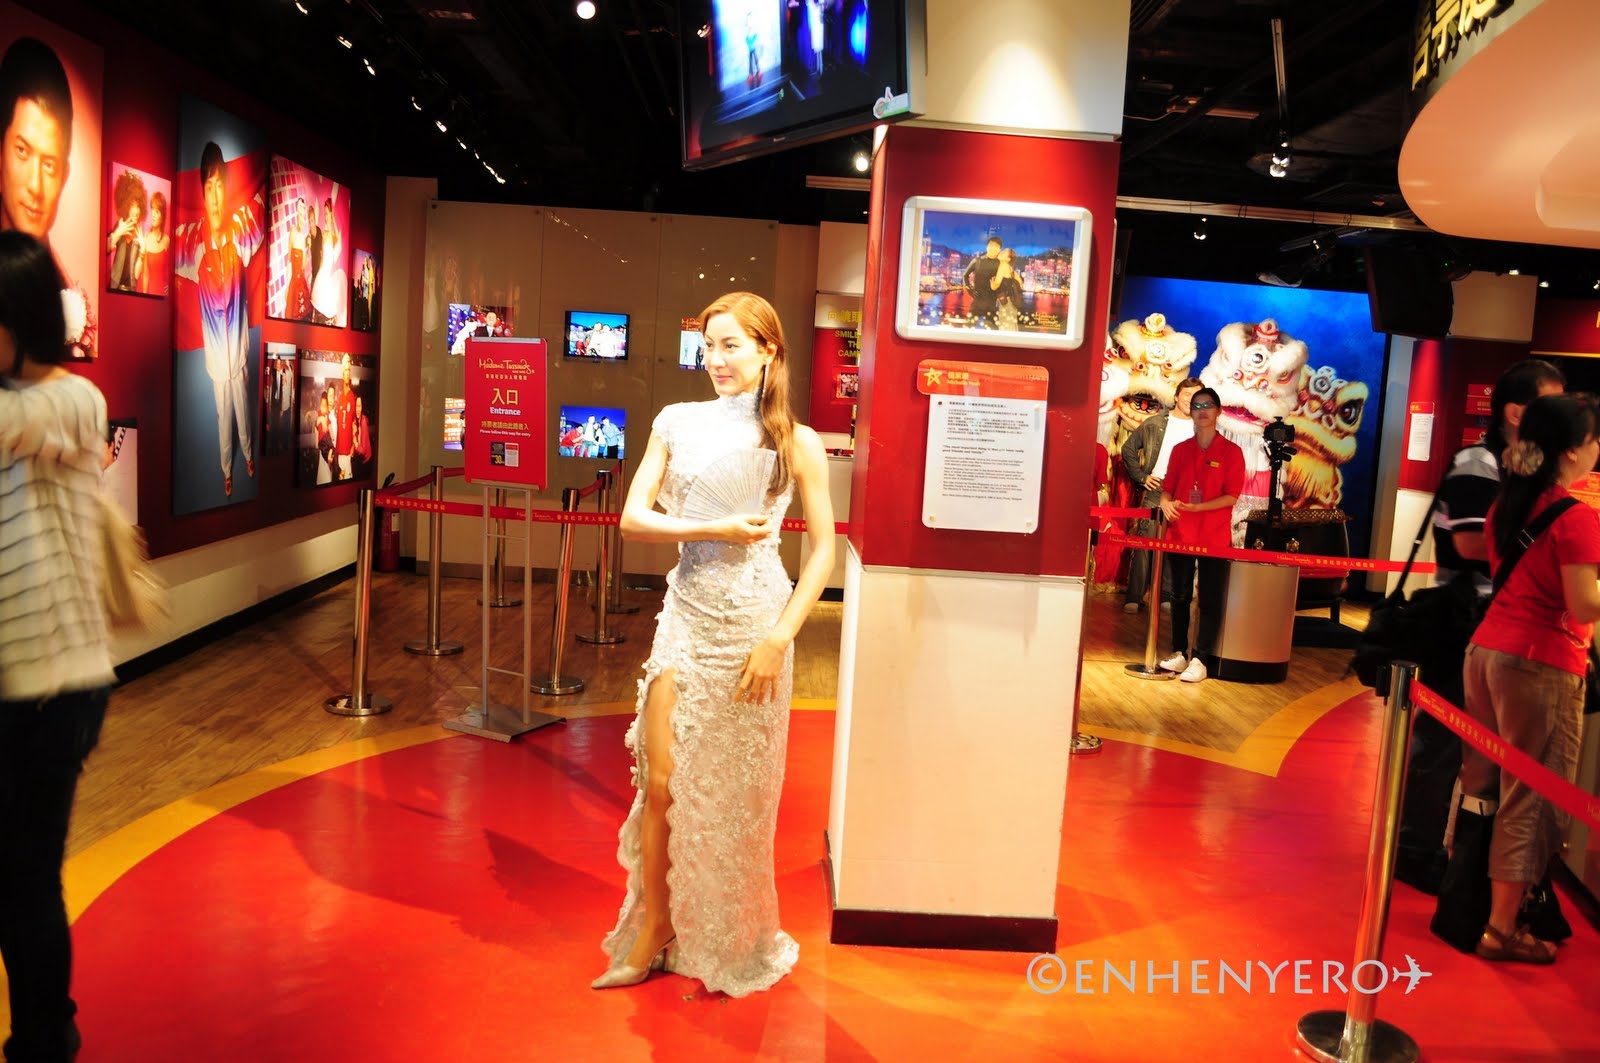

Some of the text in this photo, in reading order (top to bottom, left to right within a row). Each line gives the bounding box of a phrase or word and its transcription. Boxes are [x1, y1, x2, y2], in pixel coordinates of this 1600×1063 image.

[479, 357, 504, 369] Madame
[491, 387, 519, 405] 入口
[489, 406, 521, 416] Entrance
